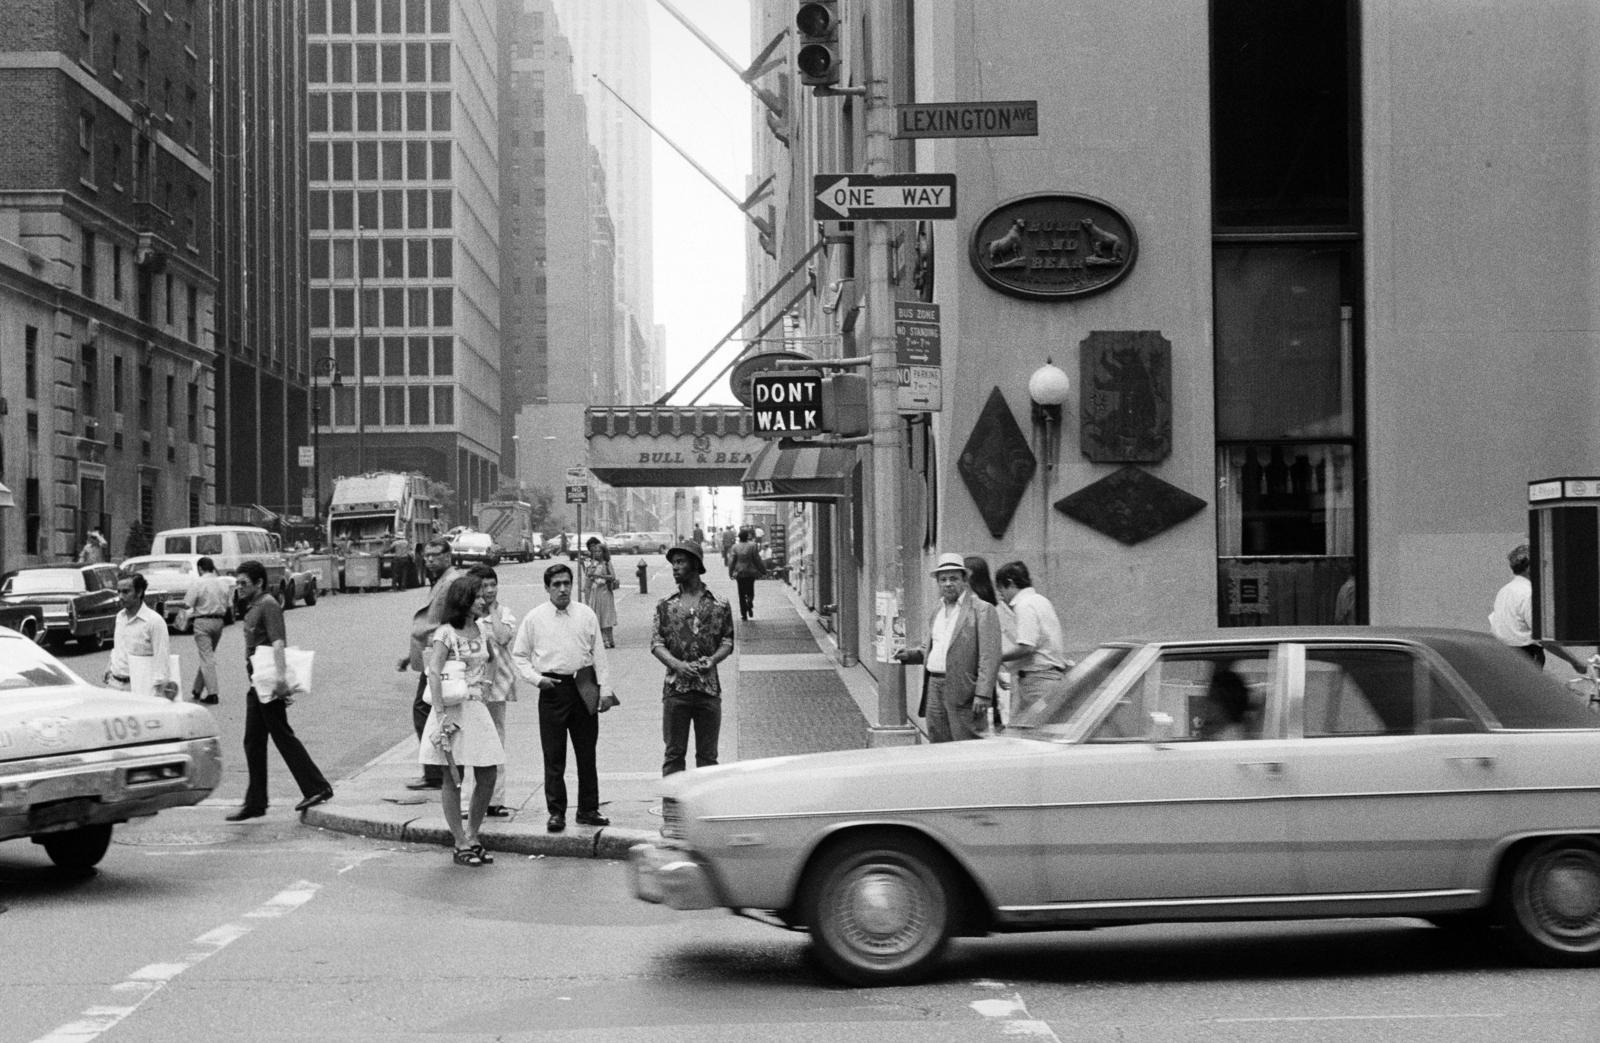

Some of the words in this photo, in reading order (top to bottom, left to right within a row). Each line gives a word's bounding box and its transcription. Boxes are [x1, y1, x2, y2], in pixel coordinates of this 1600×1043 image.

[903, 108, 1011, 132] LEXINGTON
[1012, 107, 1034, 121] AVE
[834, 188, 874, 206] ONE
[902, 187, 944, 206] WAY
[898, 308, 913, 318] BUS
[917, 309, 935, 319] ZONE
[897, 326, 906, 335] NO
[897, 368, 910, 384] NO
[756, 382, 816, 403] DONT
[757, 410, 817, 431] WALK
[639, 452, 684, 464] BULL
[696, 453, 707, 464] &
[102, 715, 140, 741] 109
